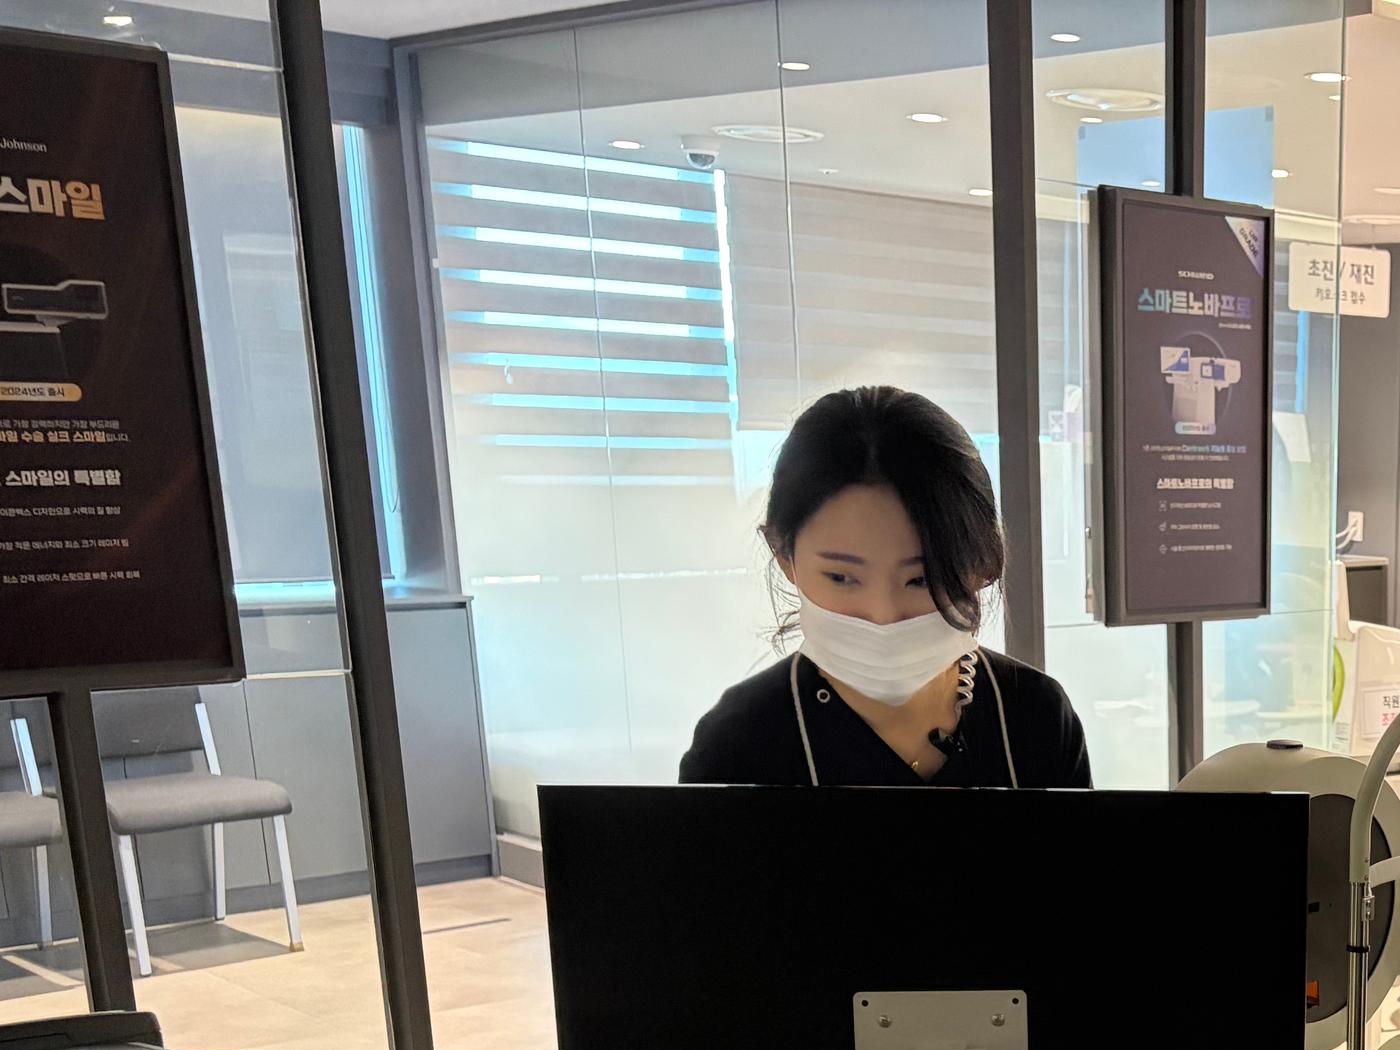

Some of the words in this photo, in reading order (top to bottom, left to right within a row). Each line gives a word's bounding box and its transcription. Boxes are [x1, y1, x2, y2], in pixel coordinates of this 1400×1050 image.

[0, 137, 47, 153] Johnson
[0, 176, 105, 220] 스마일
[1308, 259, 1335, 282] 초진
[1349, 263, 1375, 286] 재진
[1136, 287, 1251, 320] 스마트노바프로
[21, 431, 44, 443] 수술
[47, 431, 71, 443] 실크
[5, 469, 71, 486] 스마일의
[74, 469, 122, 486] 특별함
[33, 506, 72, 516] 디자인으로
[1383, 695, 1400, 709] 직원
